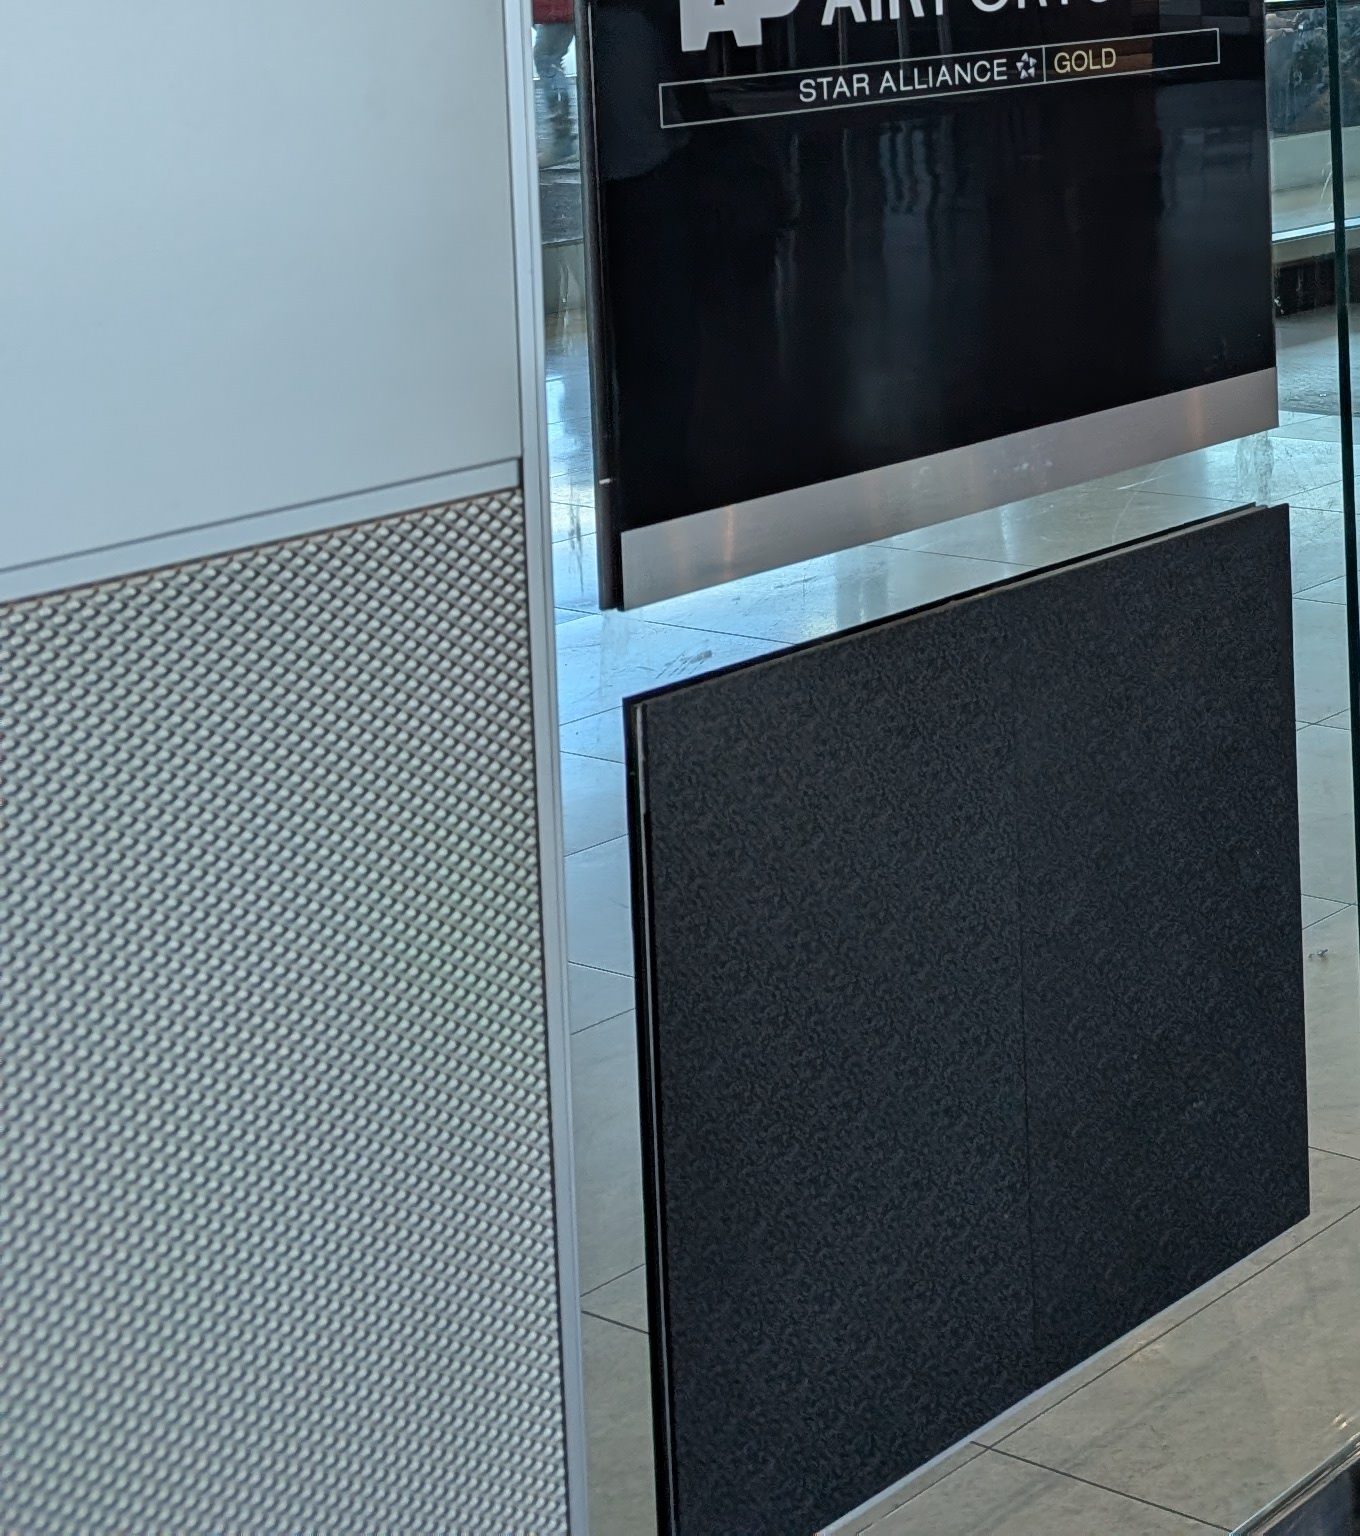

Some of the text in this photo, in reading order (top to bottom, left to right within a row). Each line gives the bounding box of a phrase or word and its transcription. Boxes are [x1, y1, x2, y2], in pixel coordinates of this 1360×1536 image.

[799, 46, 1118, 104] STAR ALLIANCE GOLD
